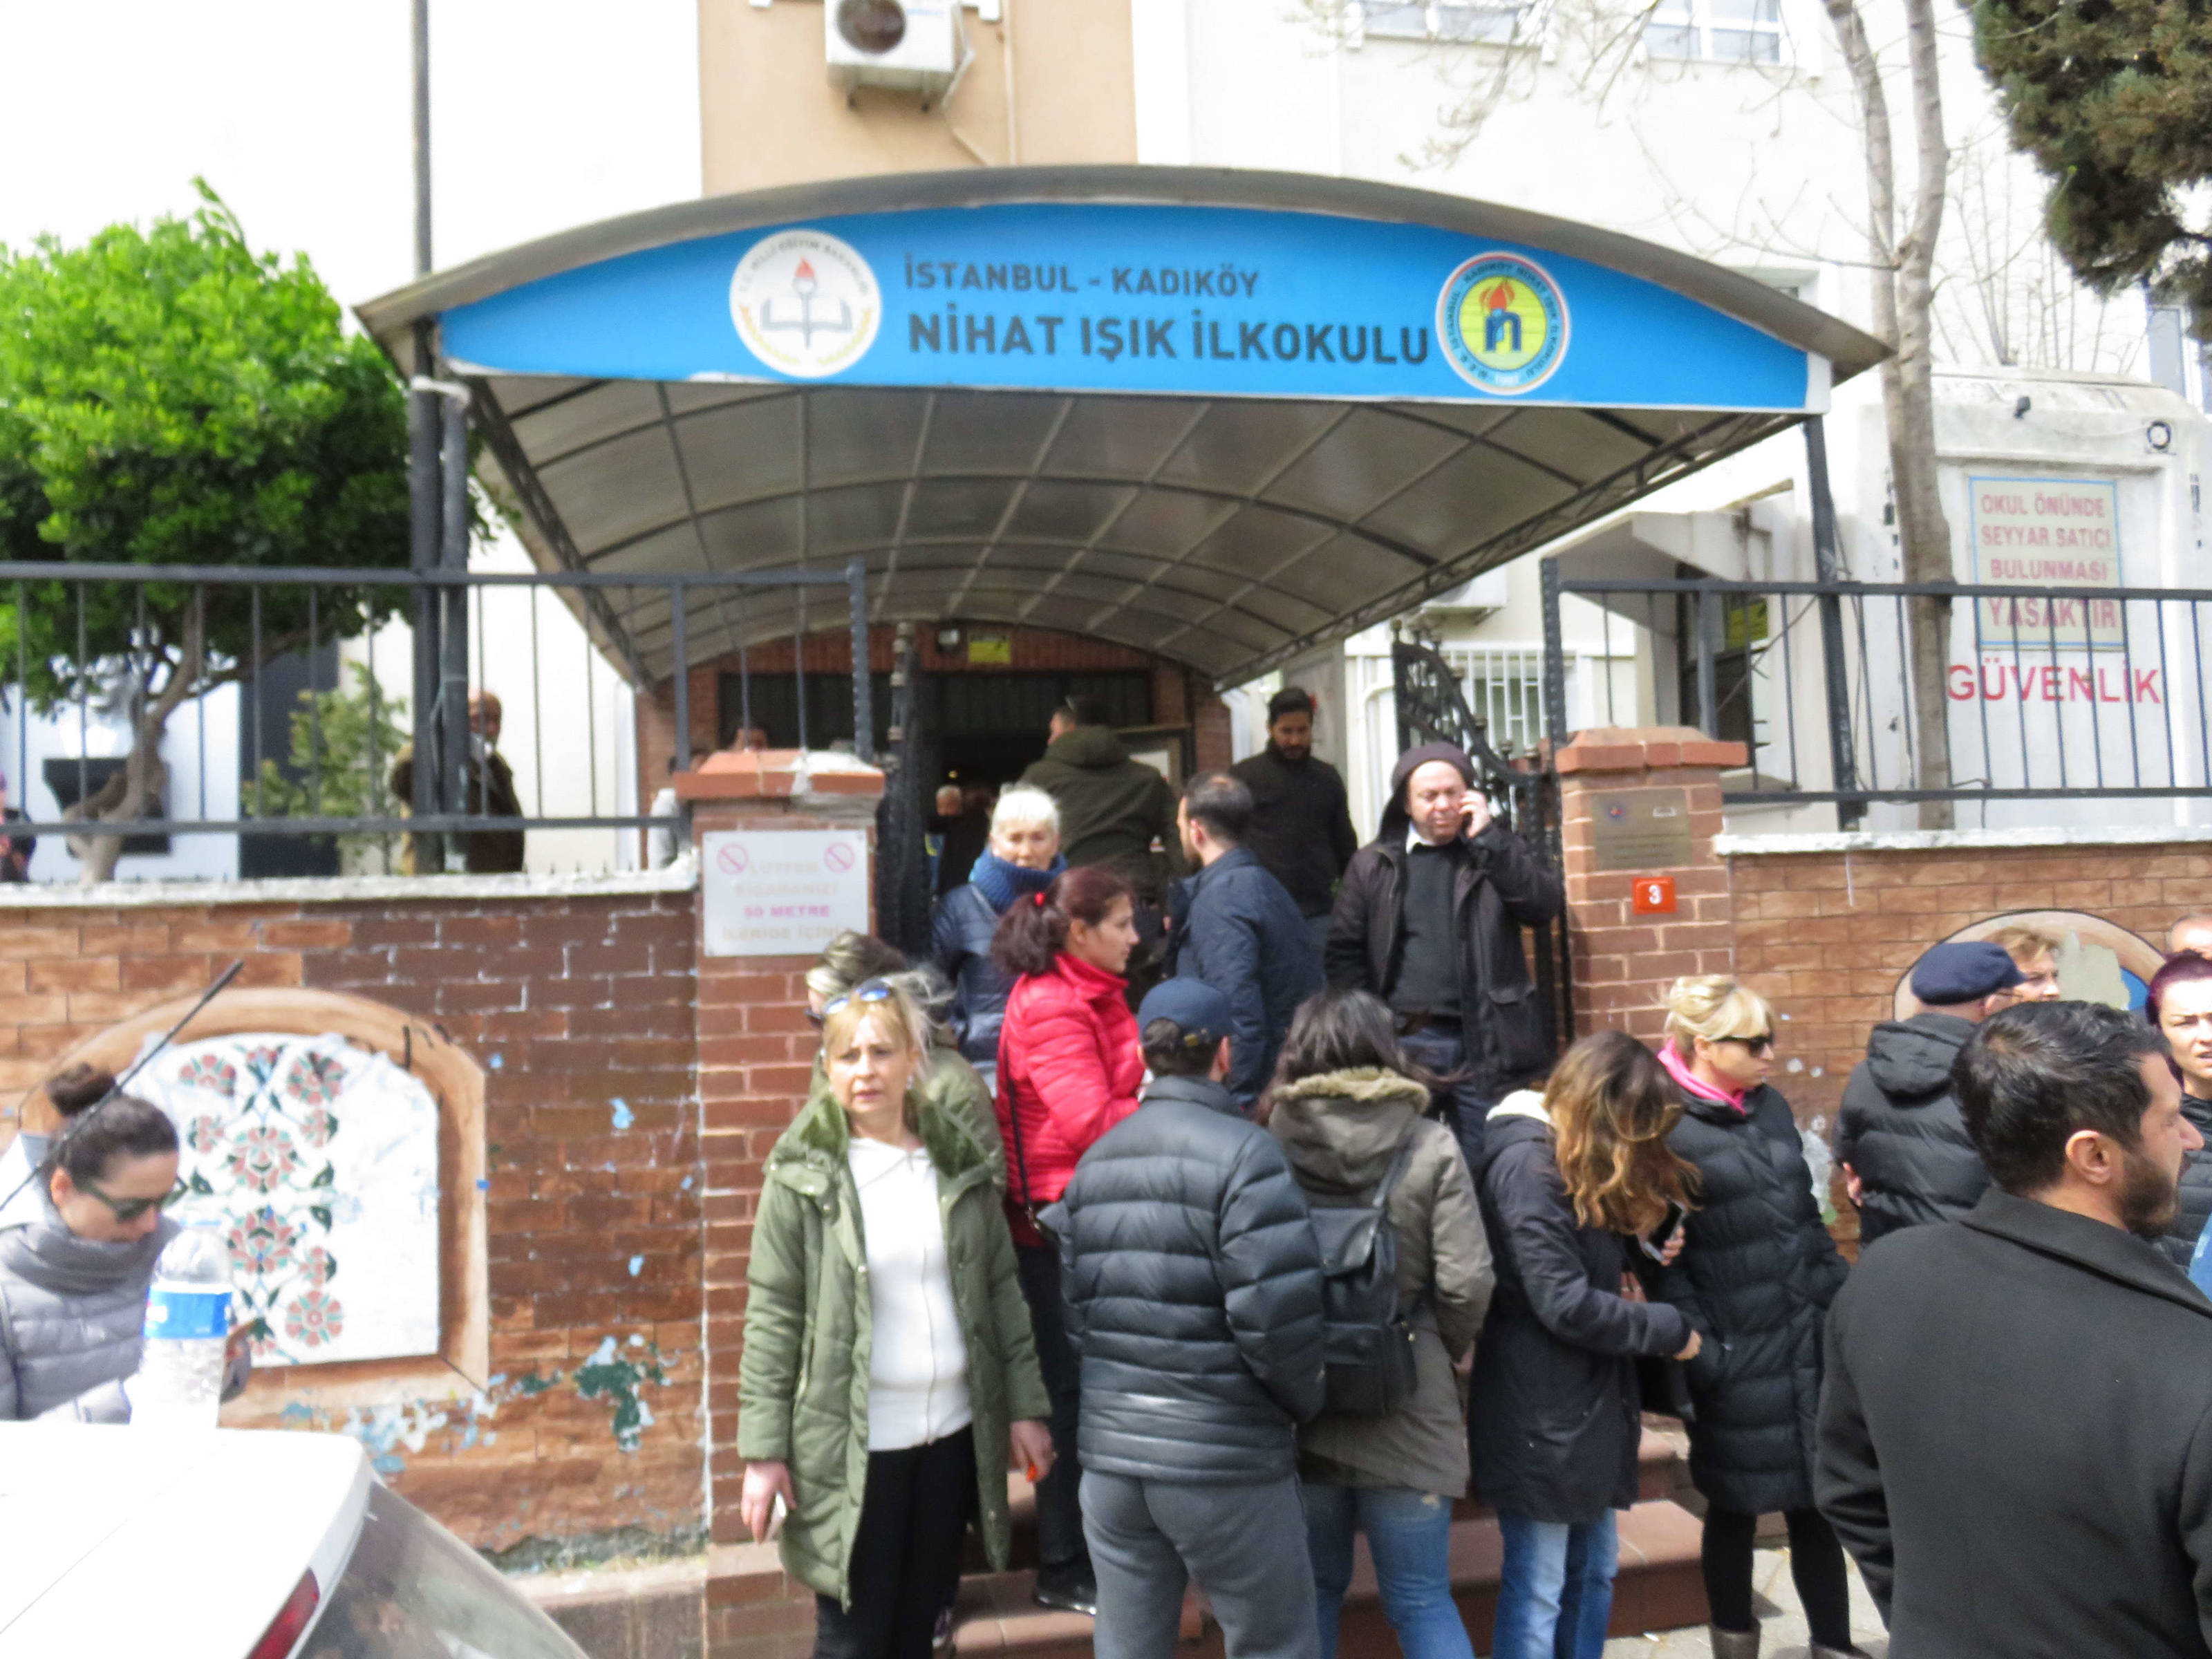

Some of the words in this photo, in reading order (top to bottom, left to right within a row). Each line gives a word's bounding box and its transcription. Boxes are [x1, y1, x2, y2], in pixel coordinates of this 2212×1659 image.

[904, 252, 1078, 292] İSTANBUL
[1112, 263, 1259, 298] KADIKÖY
[908, 302, 1065, 355] NİHAT
[1080, 315, 1177, 362] IŞIK
[1191, 309, 1429, 365] İLKOKULU
[1981, 494, 2027, 516] OKUL
[2034, 491, 2105, 518] ÖNÜNDE
[1981, 525, 2050, 547] SEYYAR
[2056, 527, 2111, 548] SATICI
[1990, 558, 2108, 582] BULUNMASI
[1947, 657, 2162, 704] GÜVENLİK
[1648, 884, 1662, 905] 3
[744, 906, 765, 918] 50
[771, 905, 830, 918] METRE
